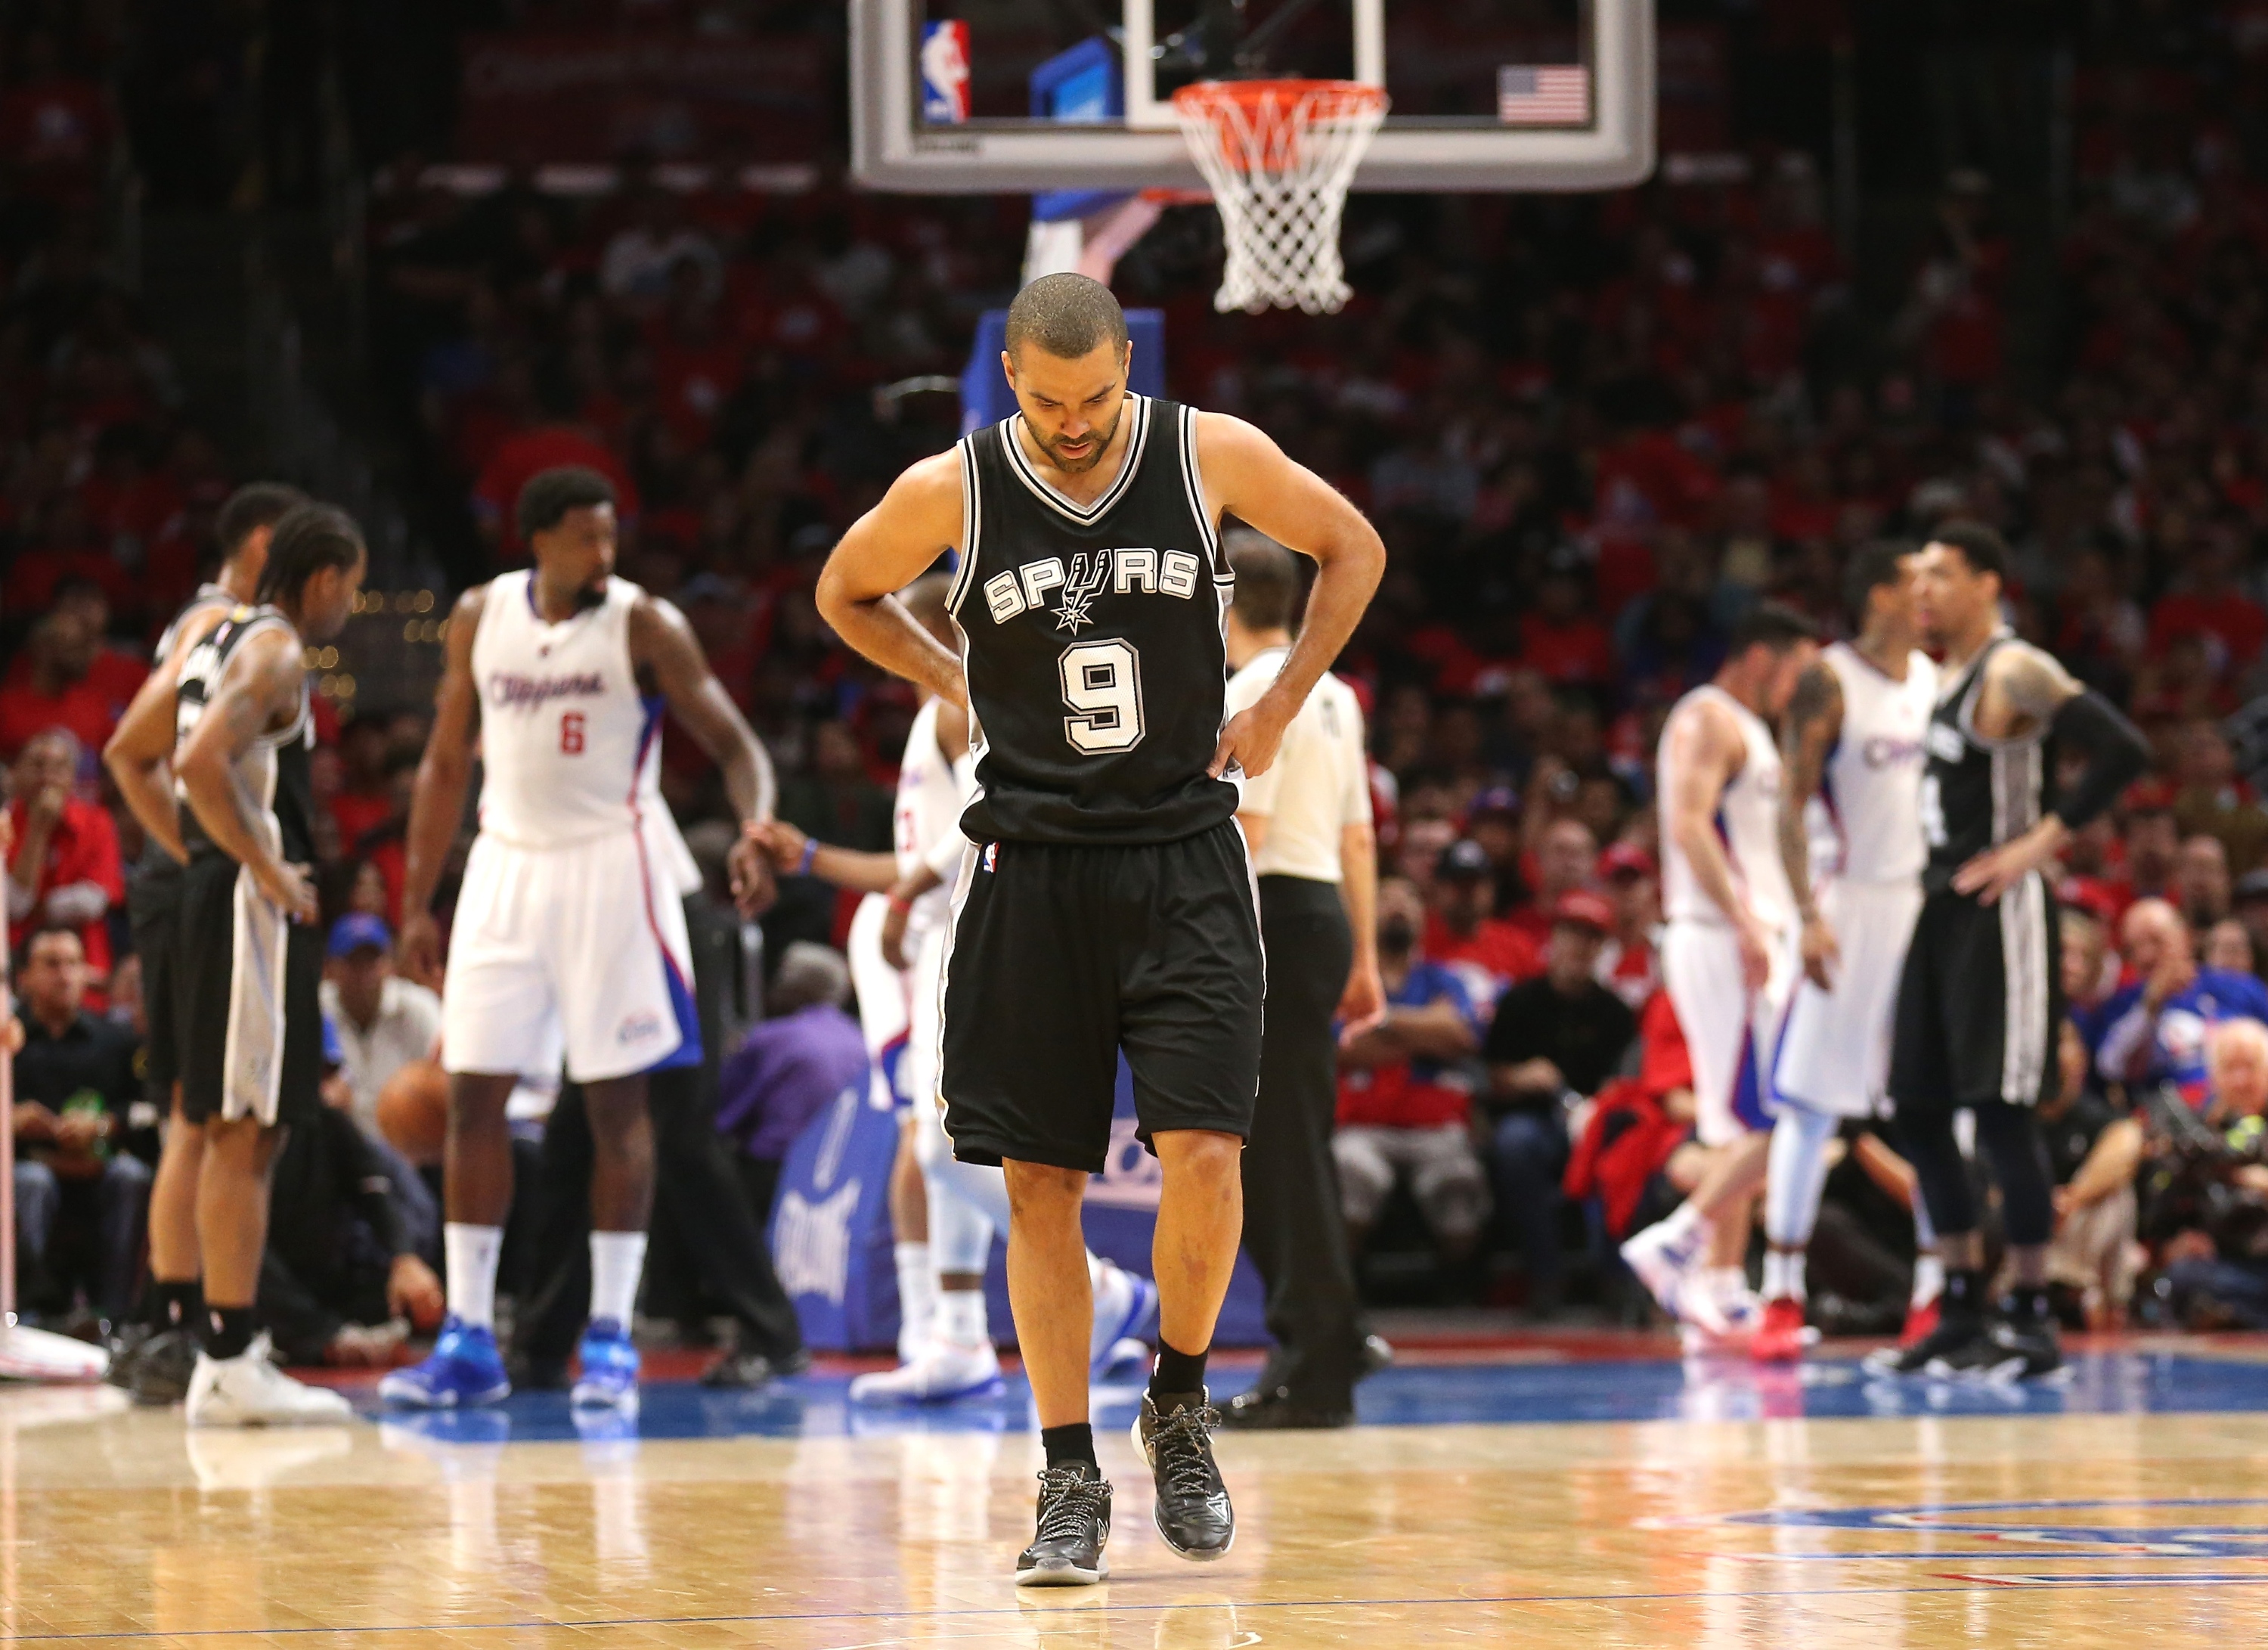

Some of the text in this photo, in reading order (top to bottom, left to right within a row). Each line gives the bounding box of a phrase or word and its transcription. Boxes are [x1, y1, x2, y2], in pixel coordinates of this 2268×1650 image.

[984, 547, 1200, 636] SPURS
[559, 712, 586, 754] 6
[1058, 637, 1146, 755] 9
